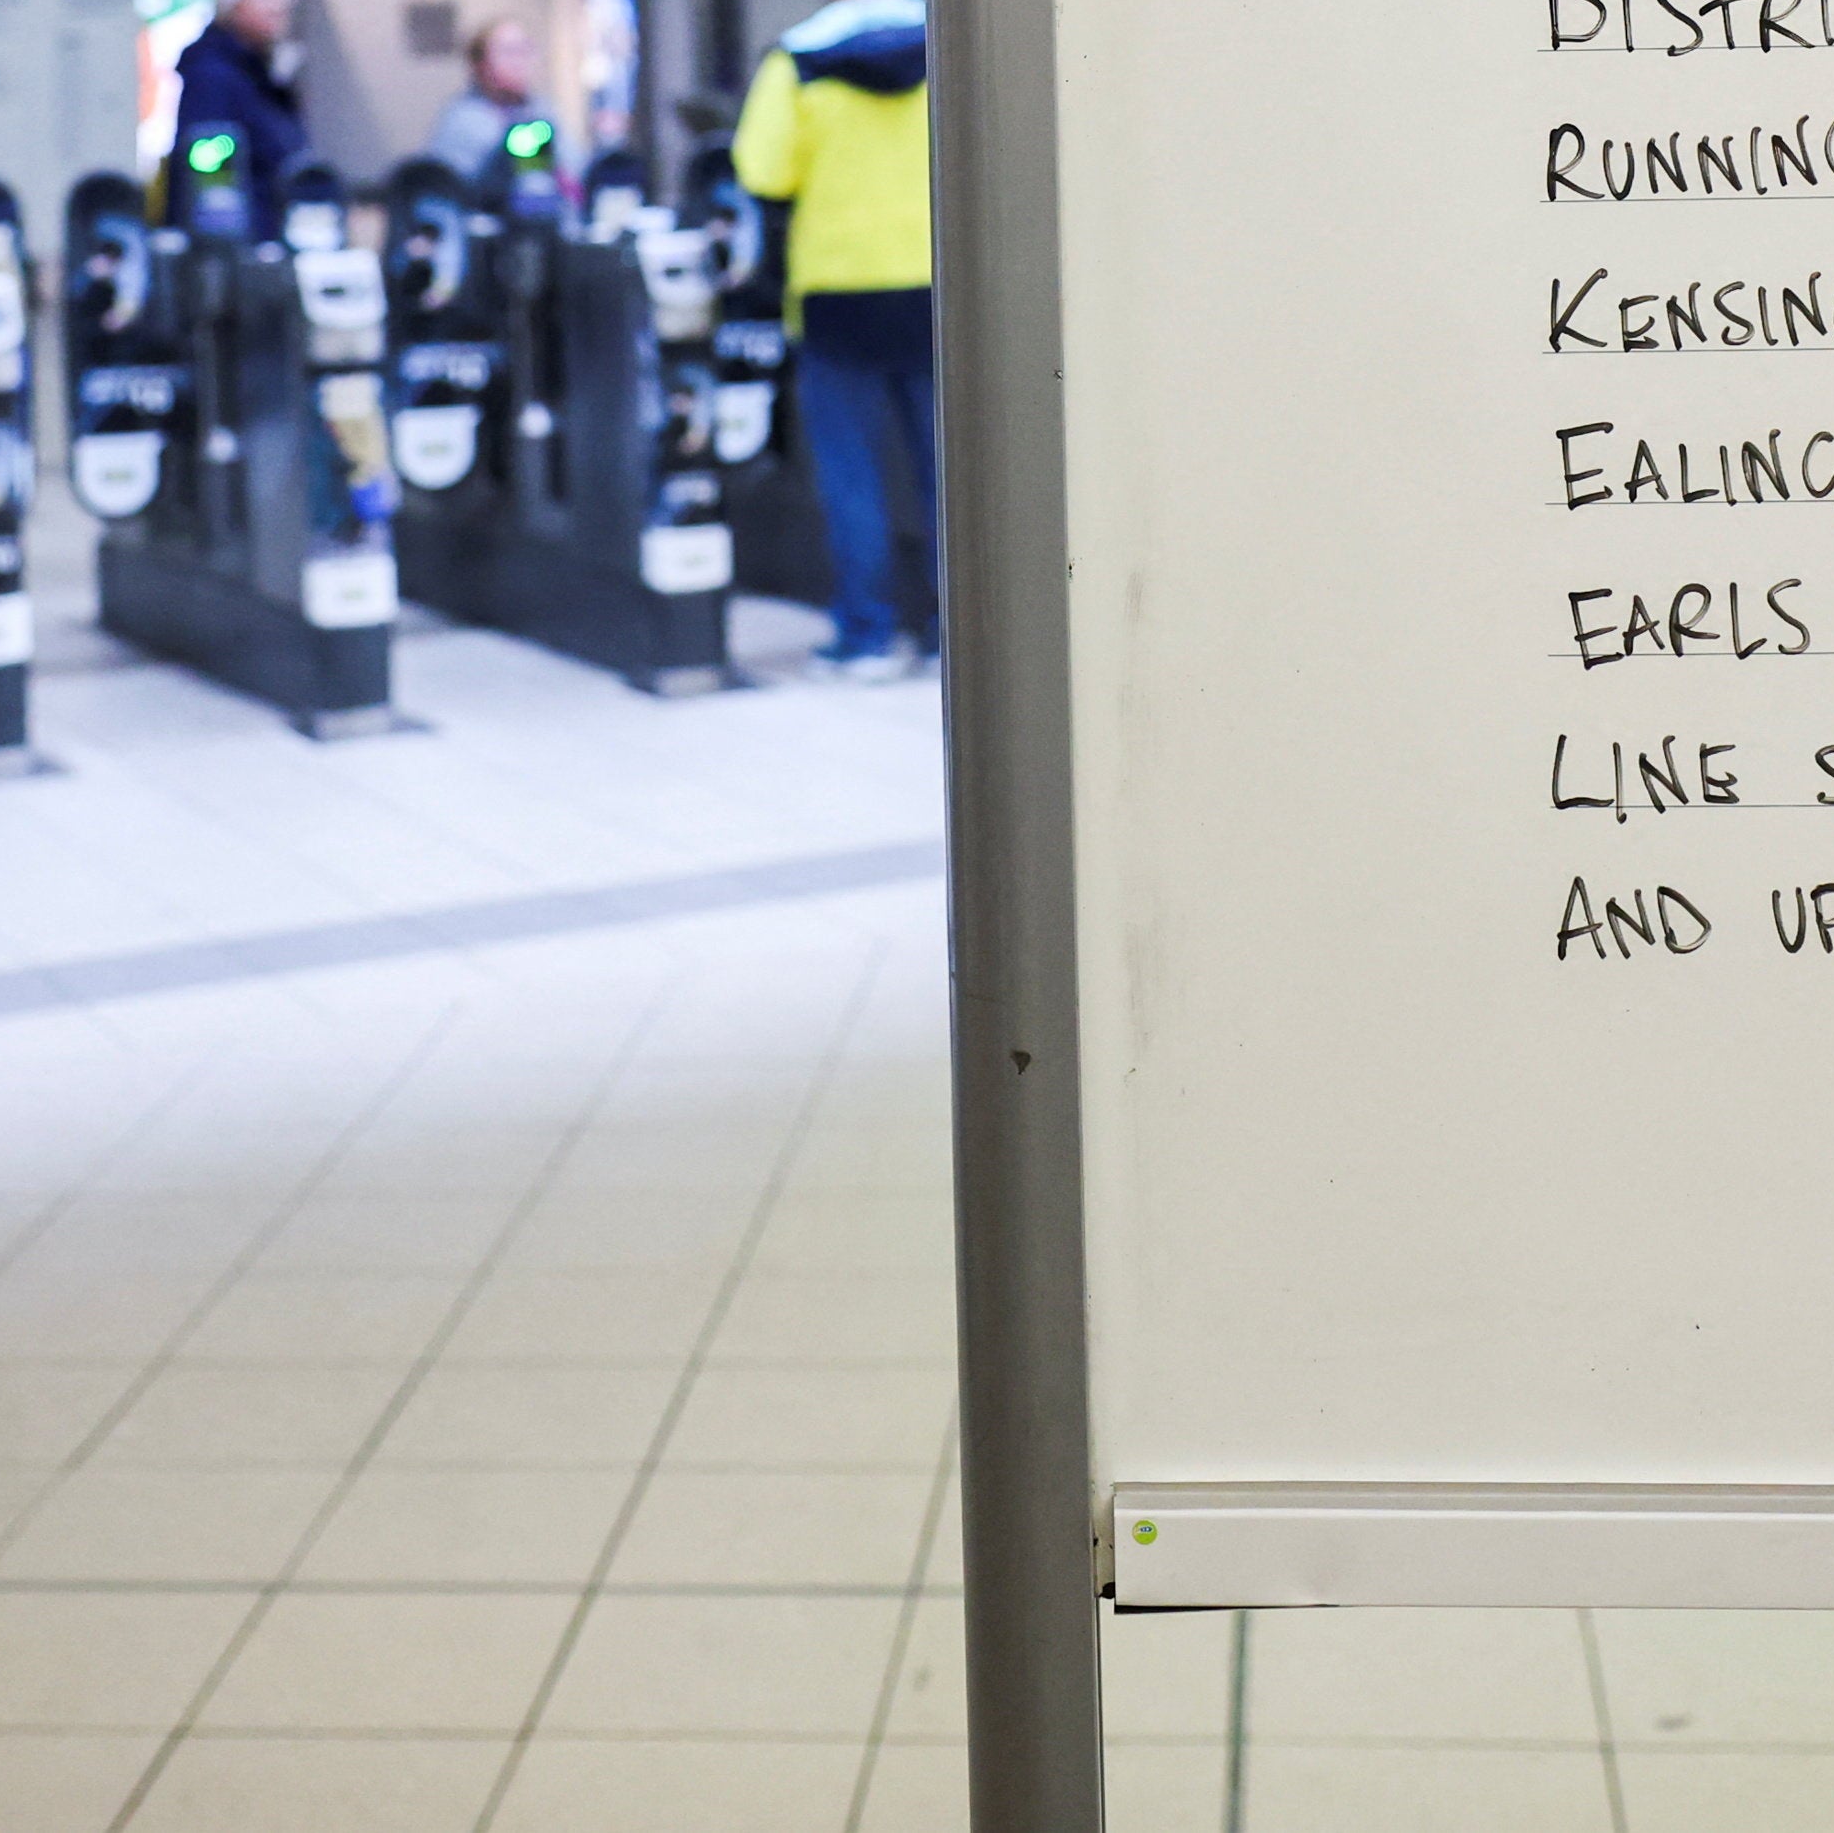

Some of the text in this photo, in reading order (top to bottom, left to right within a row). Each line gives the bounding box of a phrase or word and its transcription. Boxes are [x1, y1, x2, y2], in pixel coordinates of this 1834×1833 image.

[1569, 578, 1812, 670] EARLS
[1550, 732, 1741, 826] LINE
[1555, 874, 1713, 963] AND
